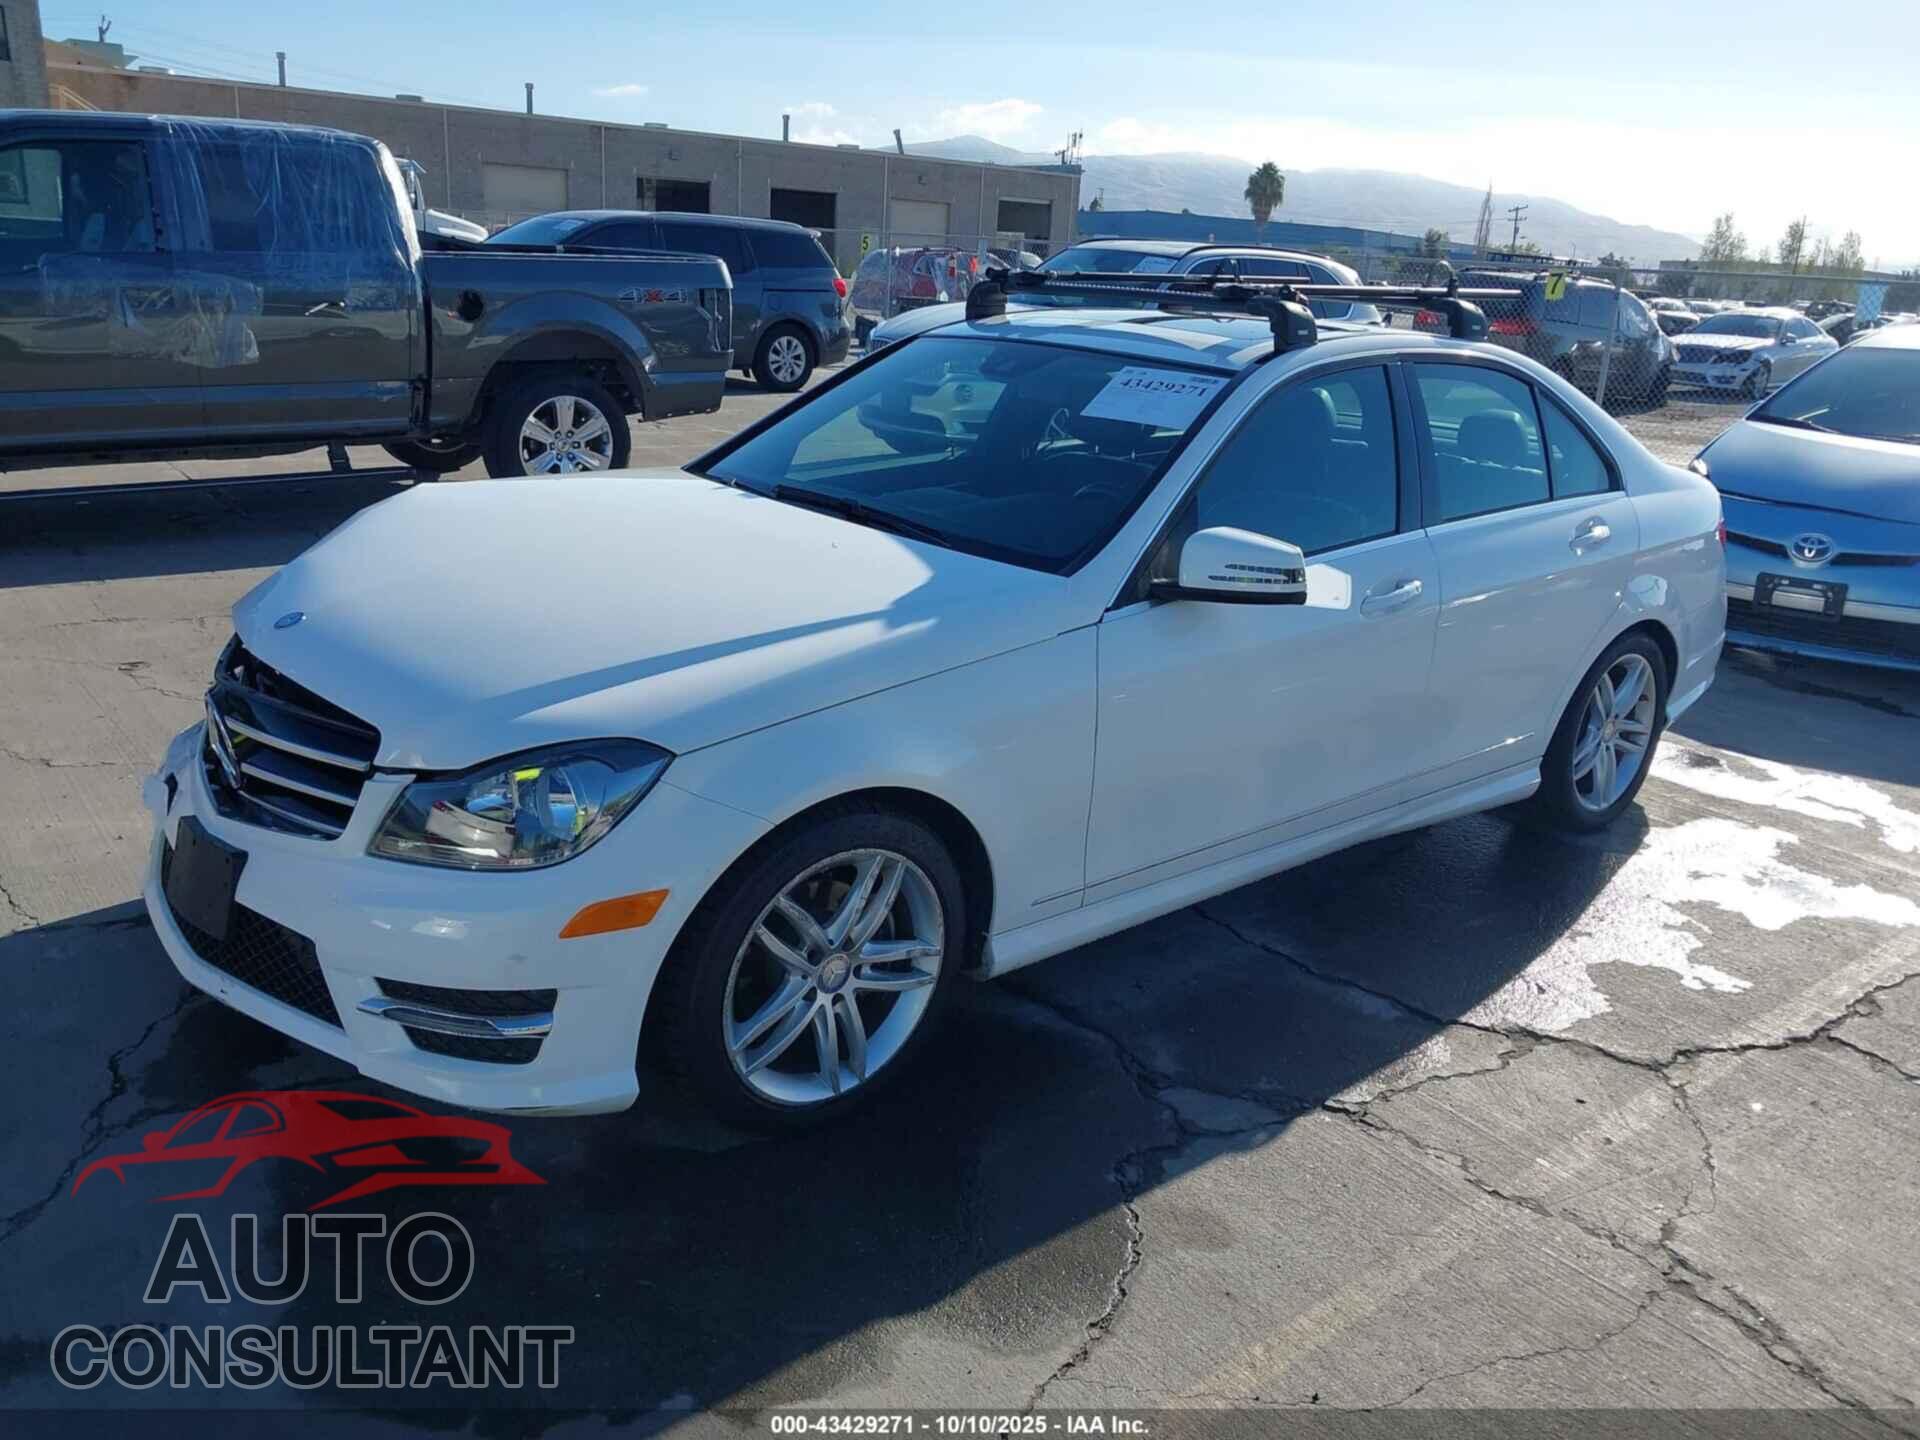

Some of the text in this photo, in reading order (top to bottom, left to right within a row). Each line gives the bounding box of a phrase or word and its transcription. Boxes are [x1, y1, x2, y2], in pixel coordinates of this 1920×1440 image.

[862, 235, 869, 251] 5
[1551, 272, 1564, 295] 7
[1120, 378, 1208, 397] 43429271
